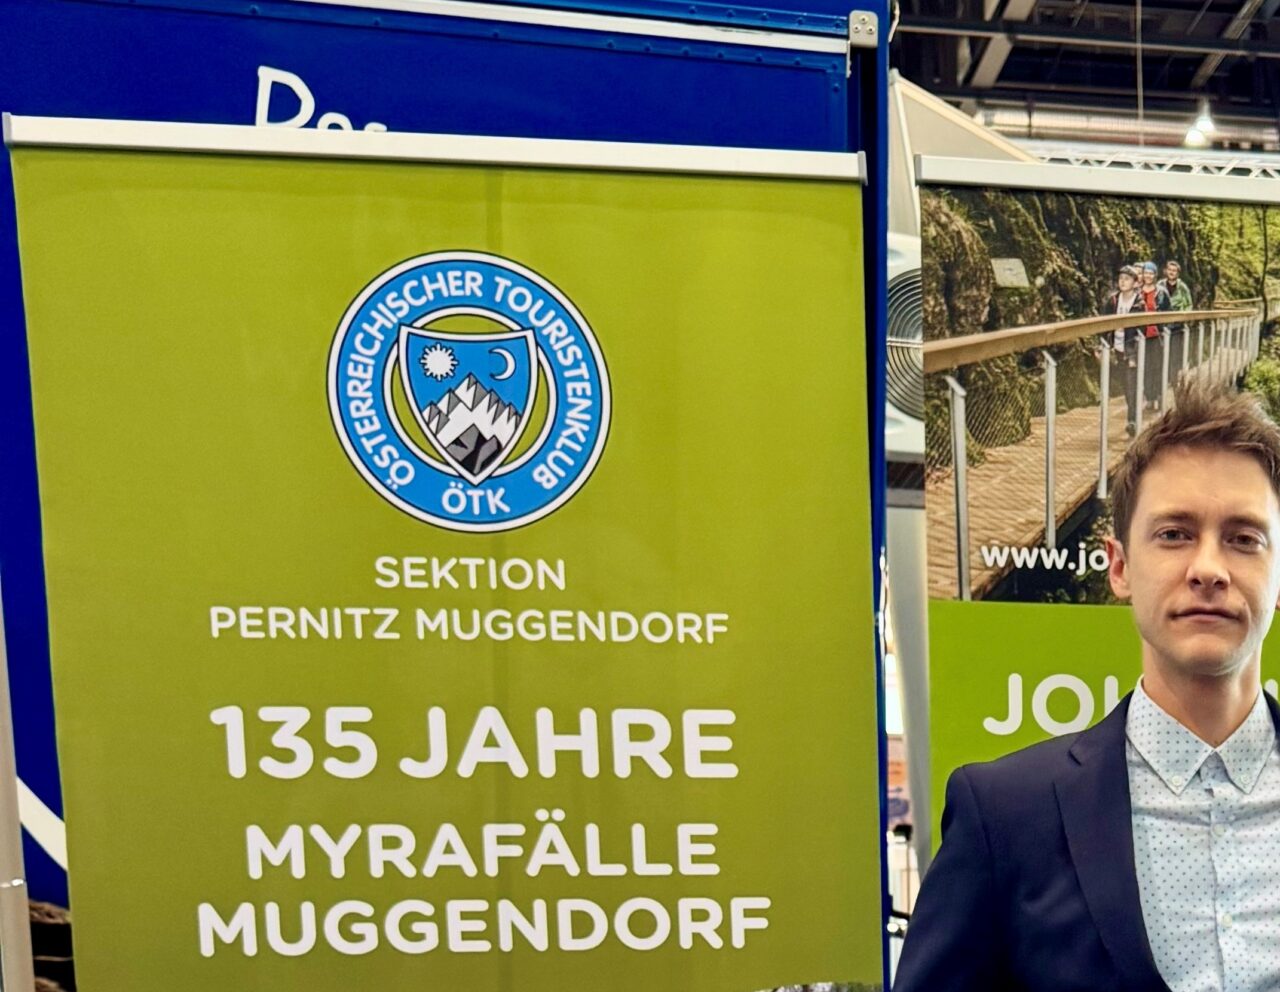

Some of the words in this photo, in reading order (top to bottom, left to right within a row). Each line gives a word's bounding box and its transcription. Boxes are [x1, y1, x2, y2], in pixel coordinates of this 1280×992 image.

[347, 270, 483, 491] ÖSTERREICHISCHER
[494, 277, 592, 490] TOURISTENKLUB
[442, 482, 510, 515] ÖTK
[375, 557, 566, 590] SEKTION
[209, 606, 400, 639] PERNITZ
[416, 609, 729, 644] MUGGENDORF
[209, 705, 378, 779] 135
[399, 705, 739, 779] JAHRE
[246, 808, 720, 879] MYRAFÄLLE
[198, 896, 771, 957] MUGGENDORF
